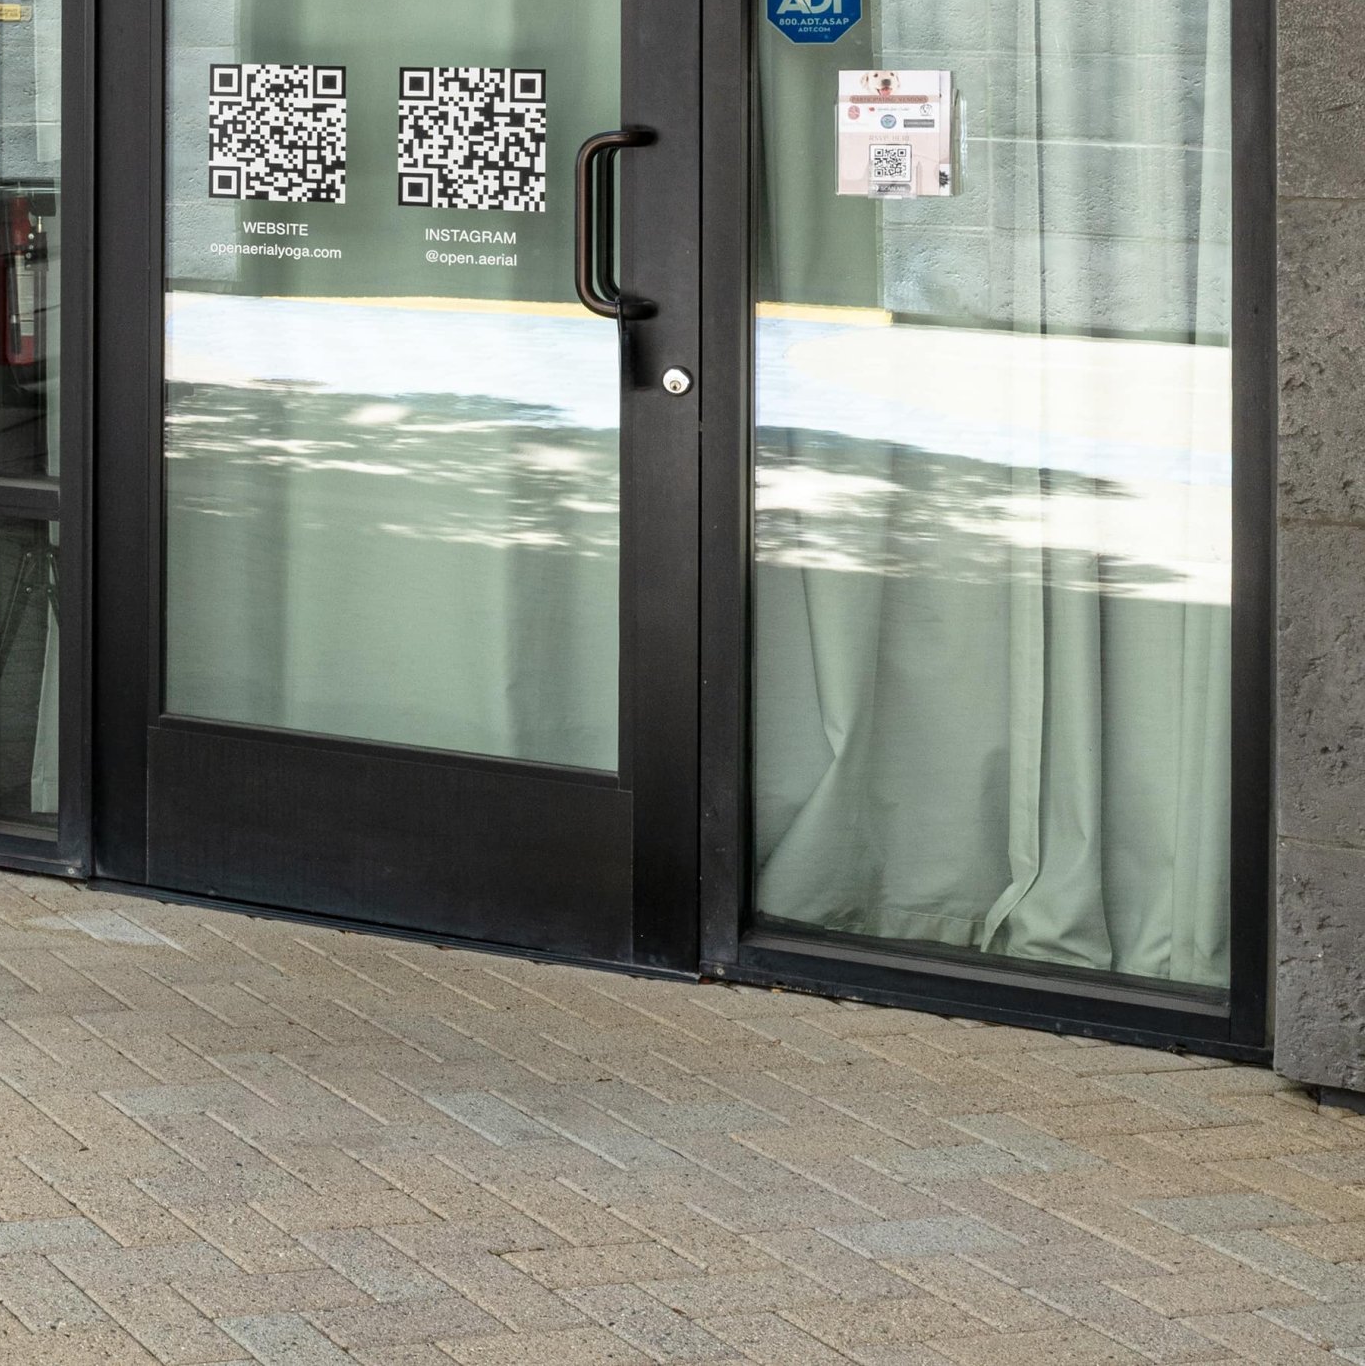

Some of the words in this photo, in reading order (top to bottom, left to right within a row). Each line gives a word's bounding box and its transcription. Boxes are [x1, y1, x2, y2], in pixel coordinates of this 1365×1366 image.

[779, 17, 850, 26] 800.ADT.ASAP
[242, 220, 309, 236] WEBSITE
[425, 227, 517, 245] INSTAGRAM
[209, 242, 342, 260] openaerialyoga.com
[425, 249, 518, 267] @open.aerial
